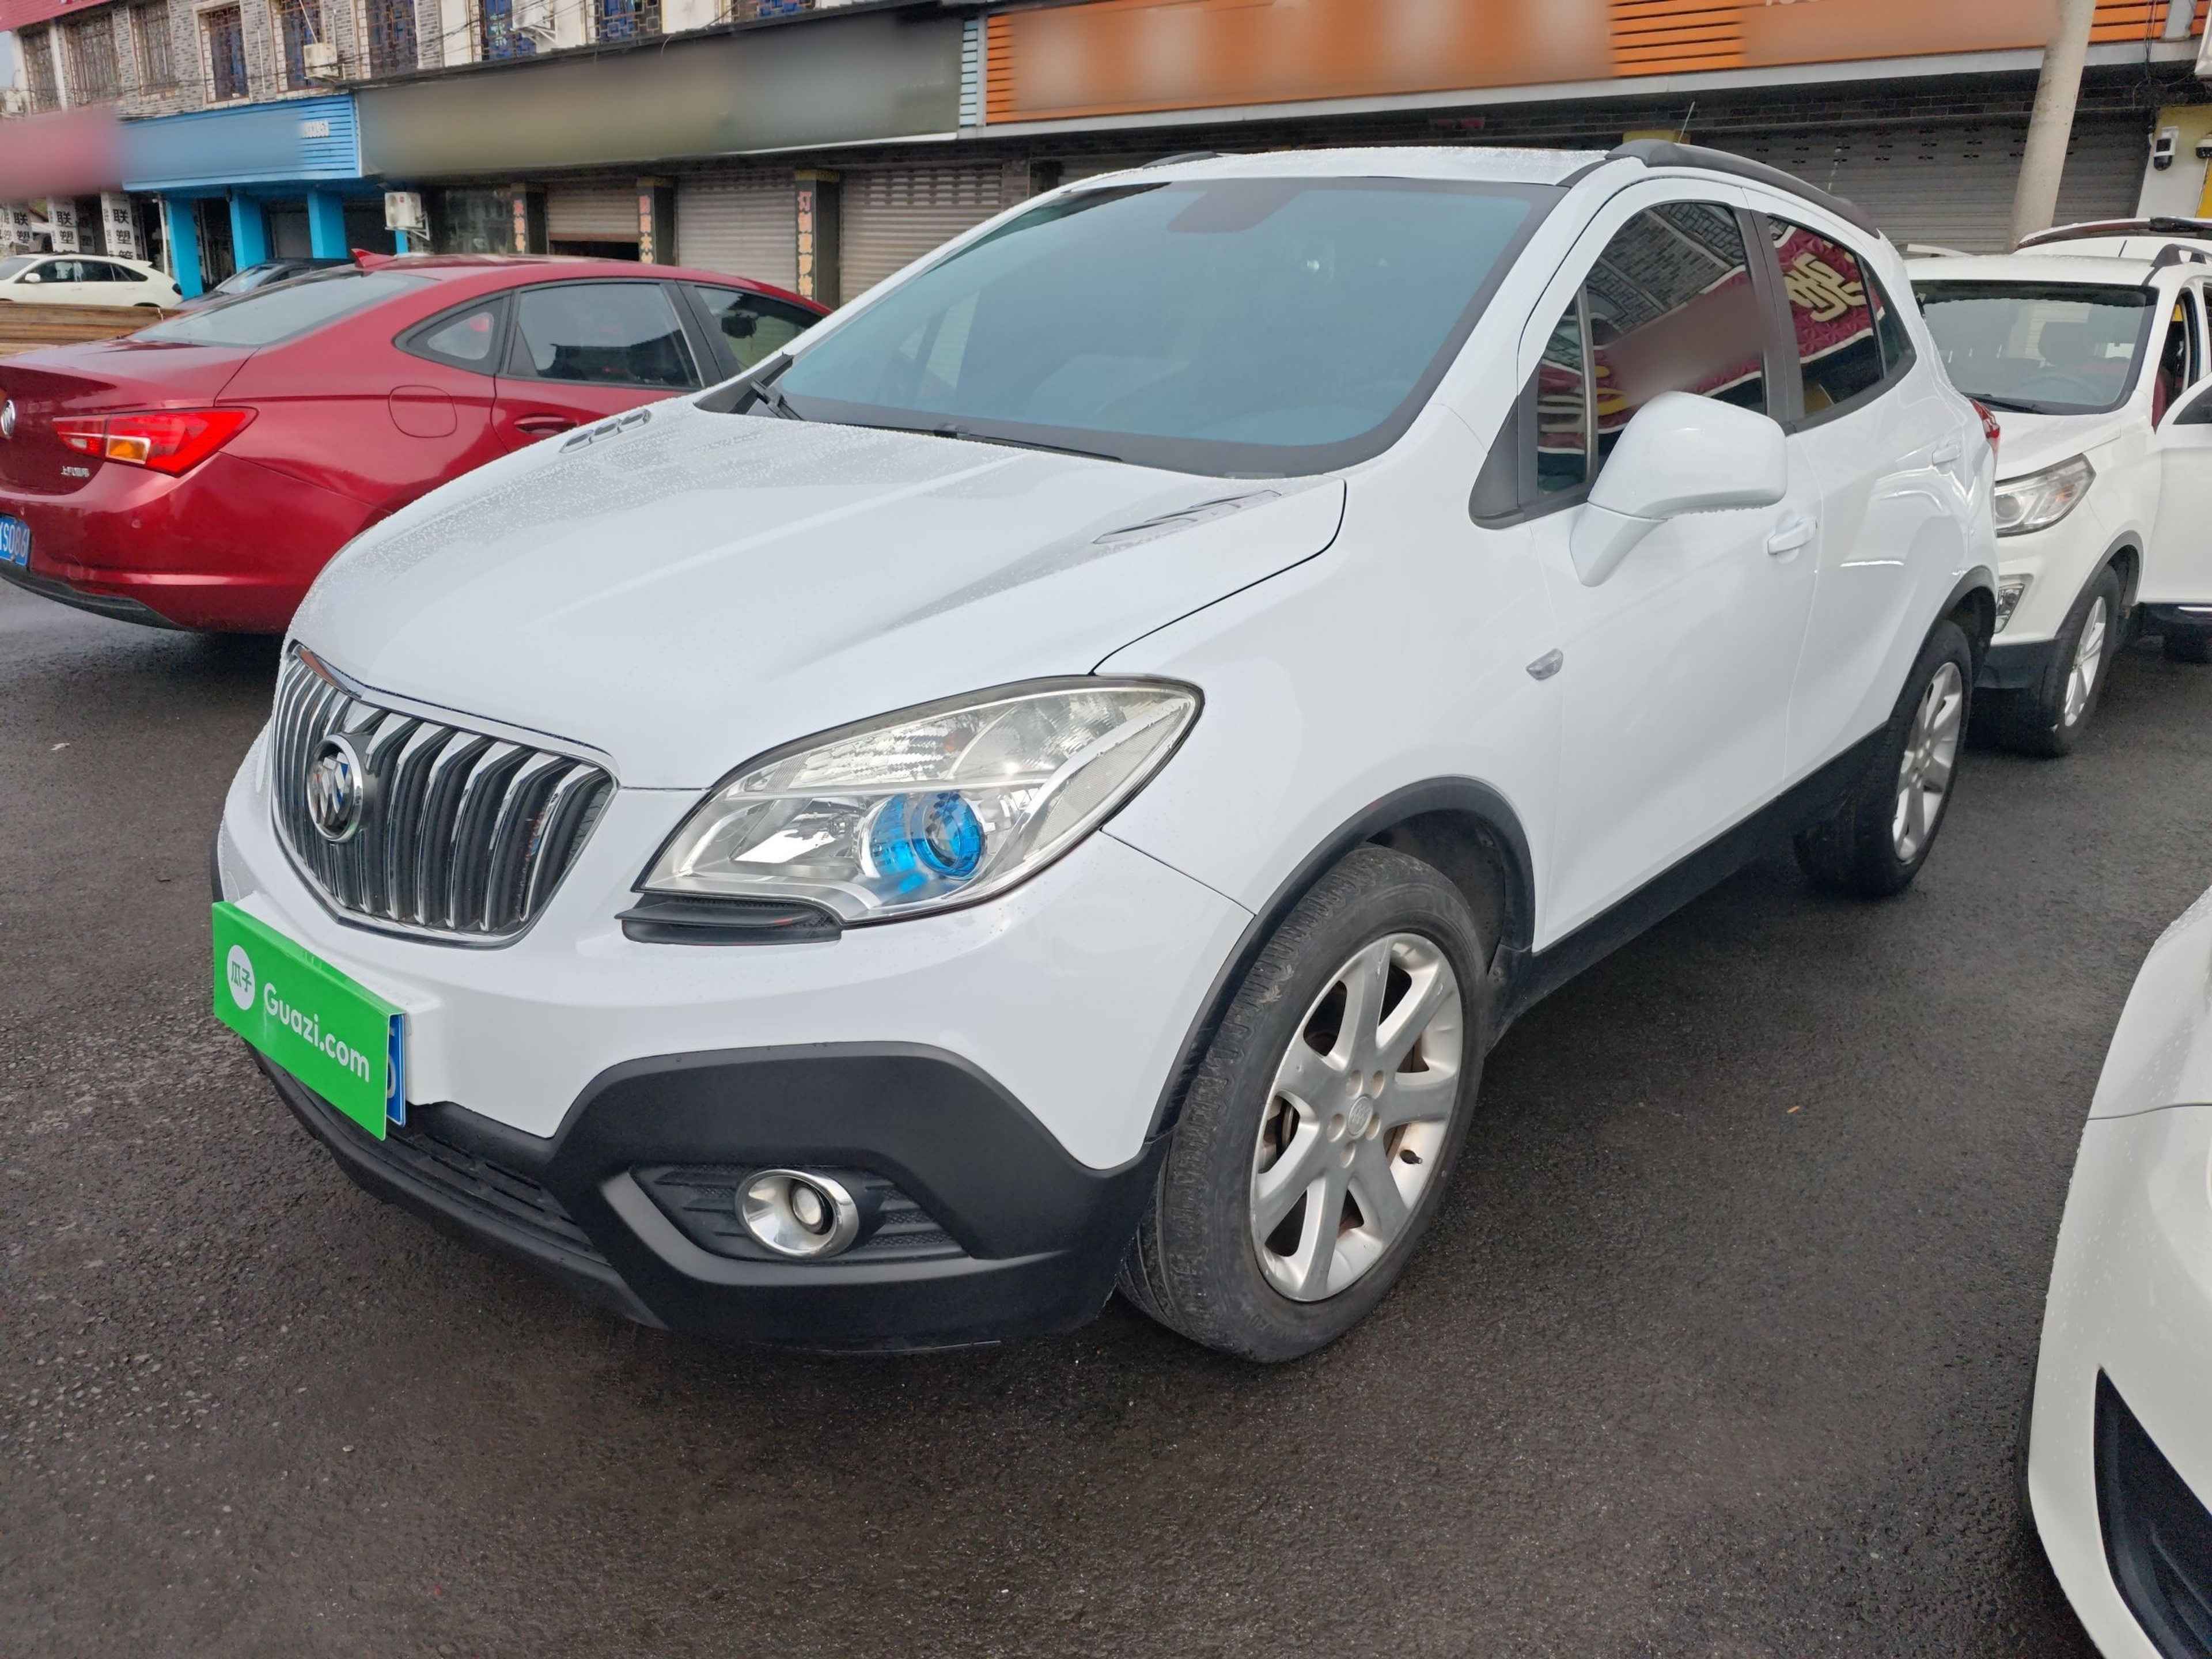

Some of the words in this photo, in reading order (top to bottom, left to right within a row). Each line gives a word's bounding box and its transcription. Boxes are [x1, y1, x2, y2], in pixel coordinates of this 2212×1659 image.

[56, 210, 75, 252] 联塑
[231, 960, 252, 993] 瓜子
[264, 982, 370, 1082] Guazi.com
